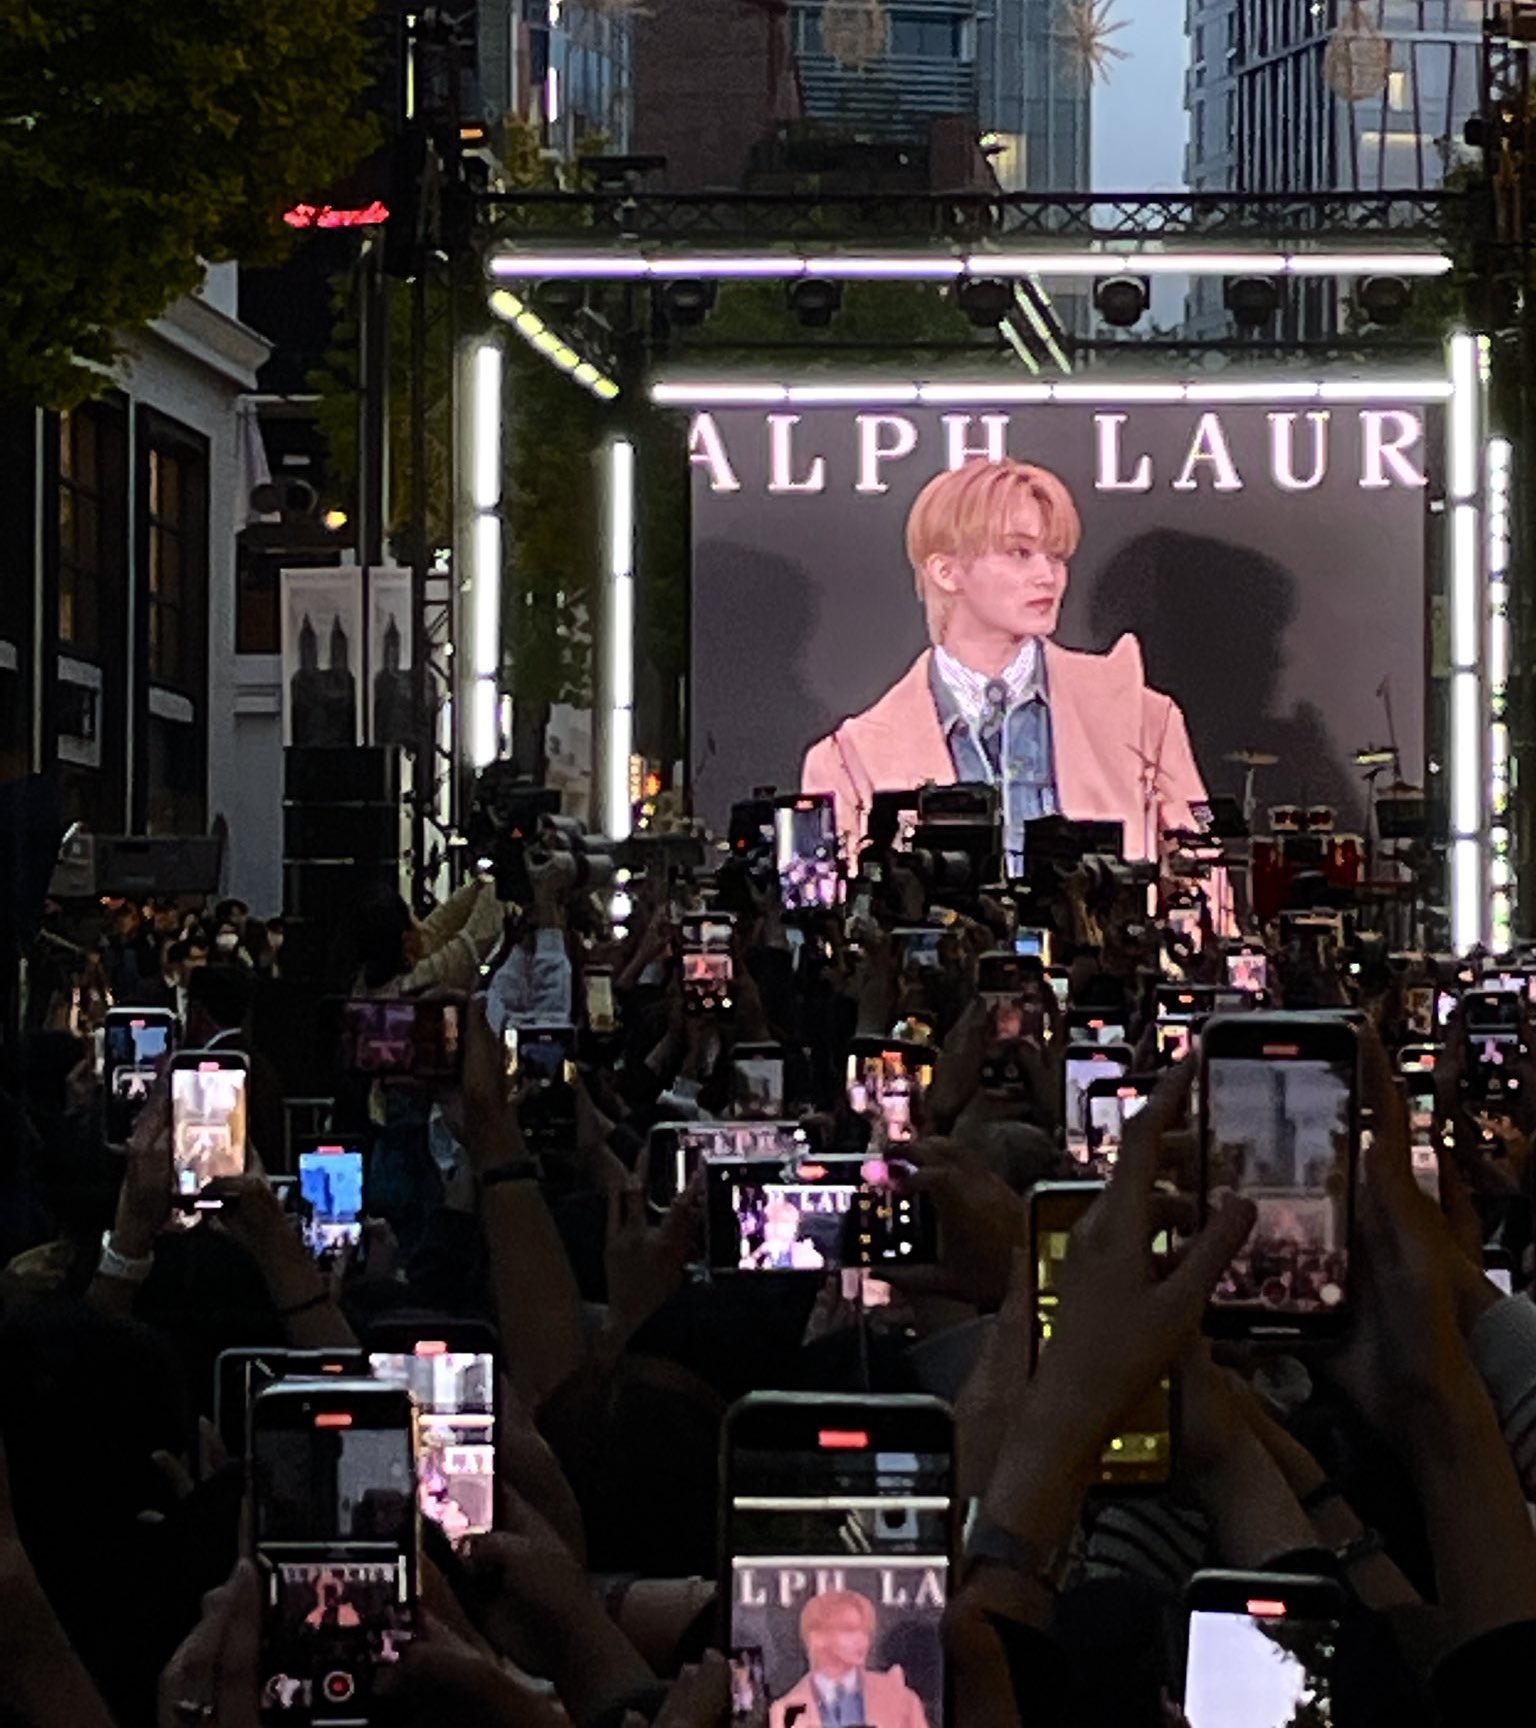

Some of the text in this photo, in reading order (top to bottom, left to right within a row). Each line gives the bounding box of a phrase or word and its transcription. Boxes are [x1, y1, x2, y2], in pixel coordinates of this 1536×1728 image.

[689, 410, 1428, 492] ALPH LAUR
[881, 1569, 945, 1607] LA
